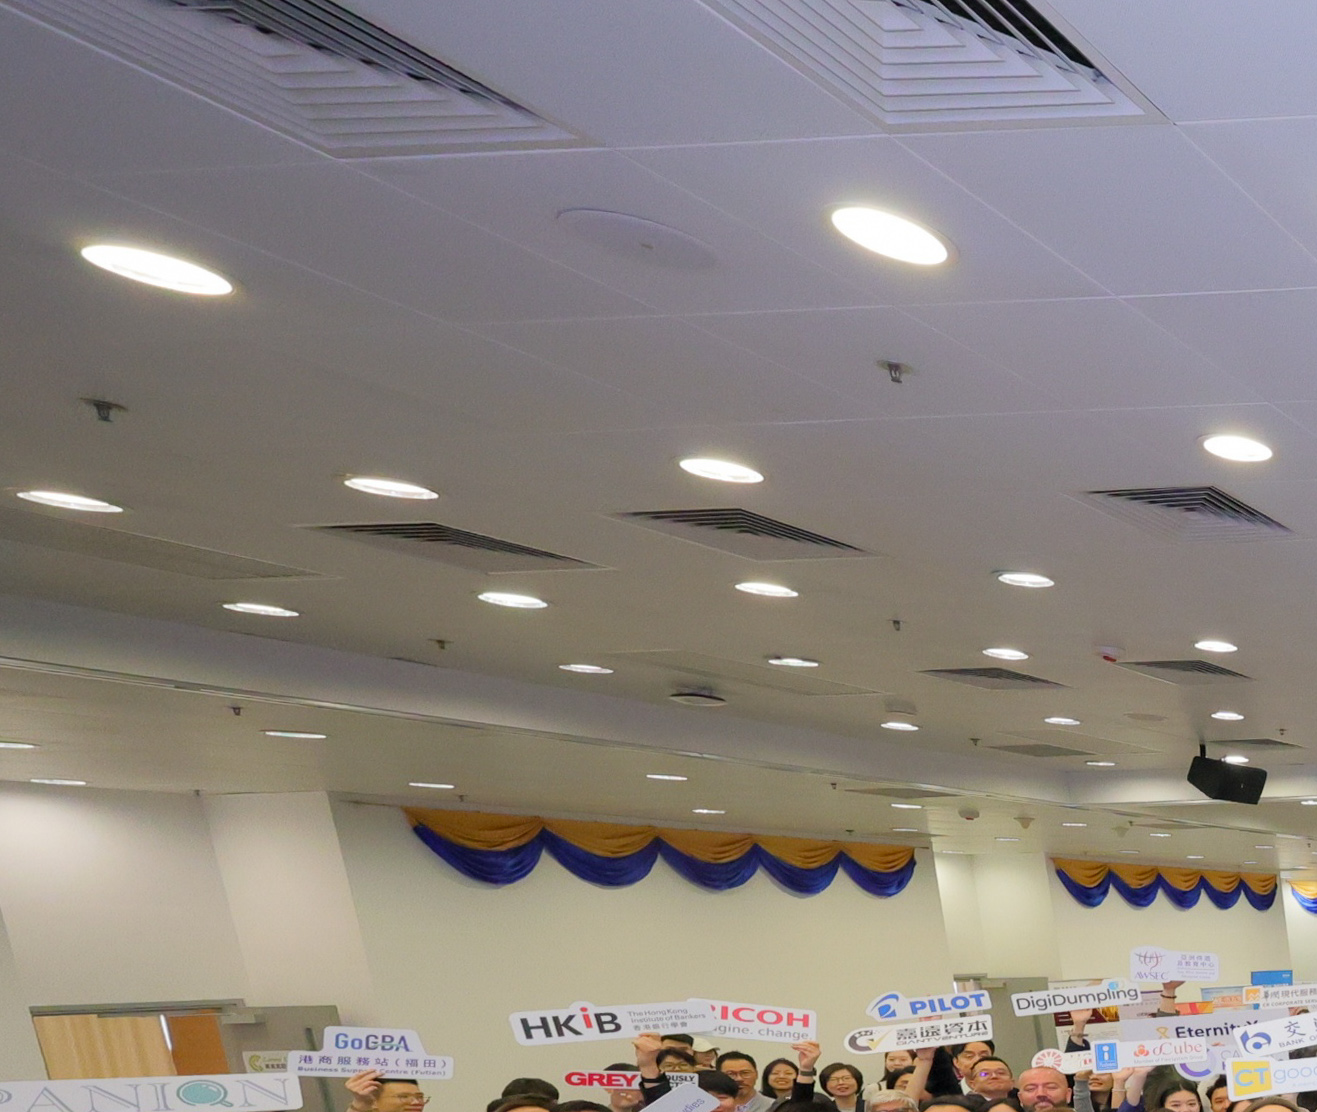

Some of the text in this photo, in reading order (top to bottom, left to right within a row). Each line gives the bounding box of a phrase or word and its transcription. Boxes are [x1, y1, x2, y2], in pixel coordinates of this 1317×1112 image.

[909, 993, 985, 1015] PILOT
[1016, 987, 1138, 1010] DigiDumpling
[520, 1006, 622, 1040] HKiB
[631, 1013, 706, 1024] Institute Bankers
[710, 1005, 810, 1028] ICOH
[335, 1033, 412, 1052] GoGBA
[758, 1028, 812, 1040] change.
[1278, 1038, 1304, 1048] BANK
[565, 1071, 640, 1087] GREY
[1234, 1068, 1270, 1087] CT
